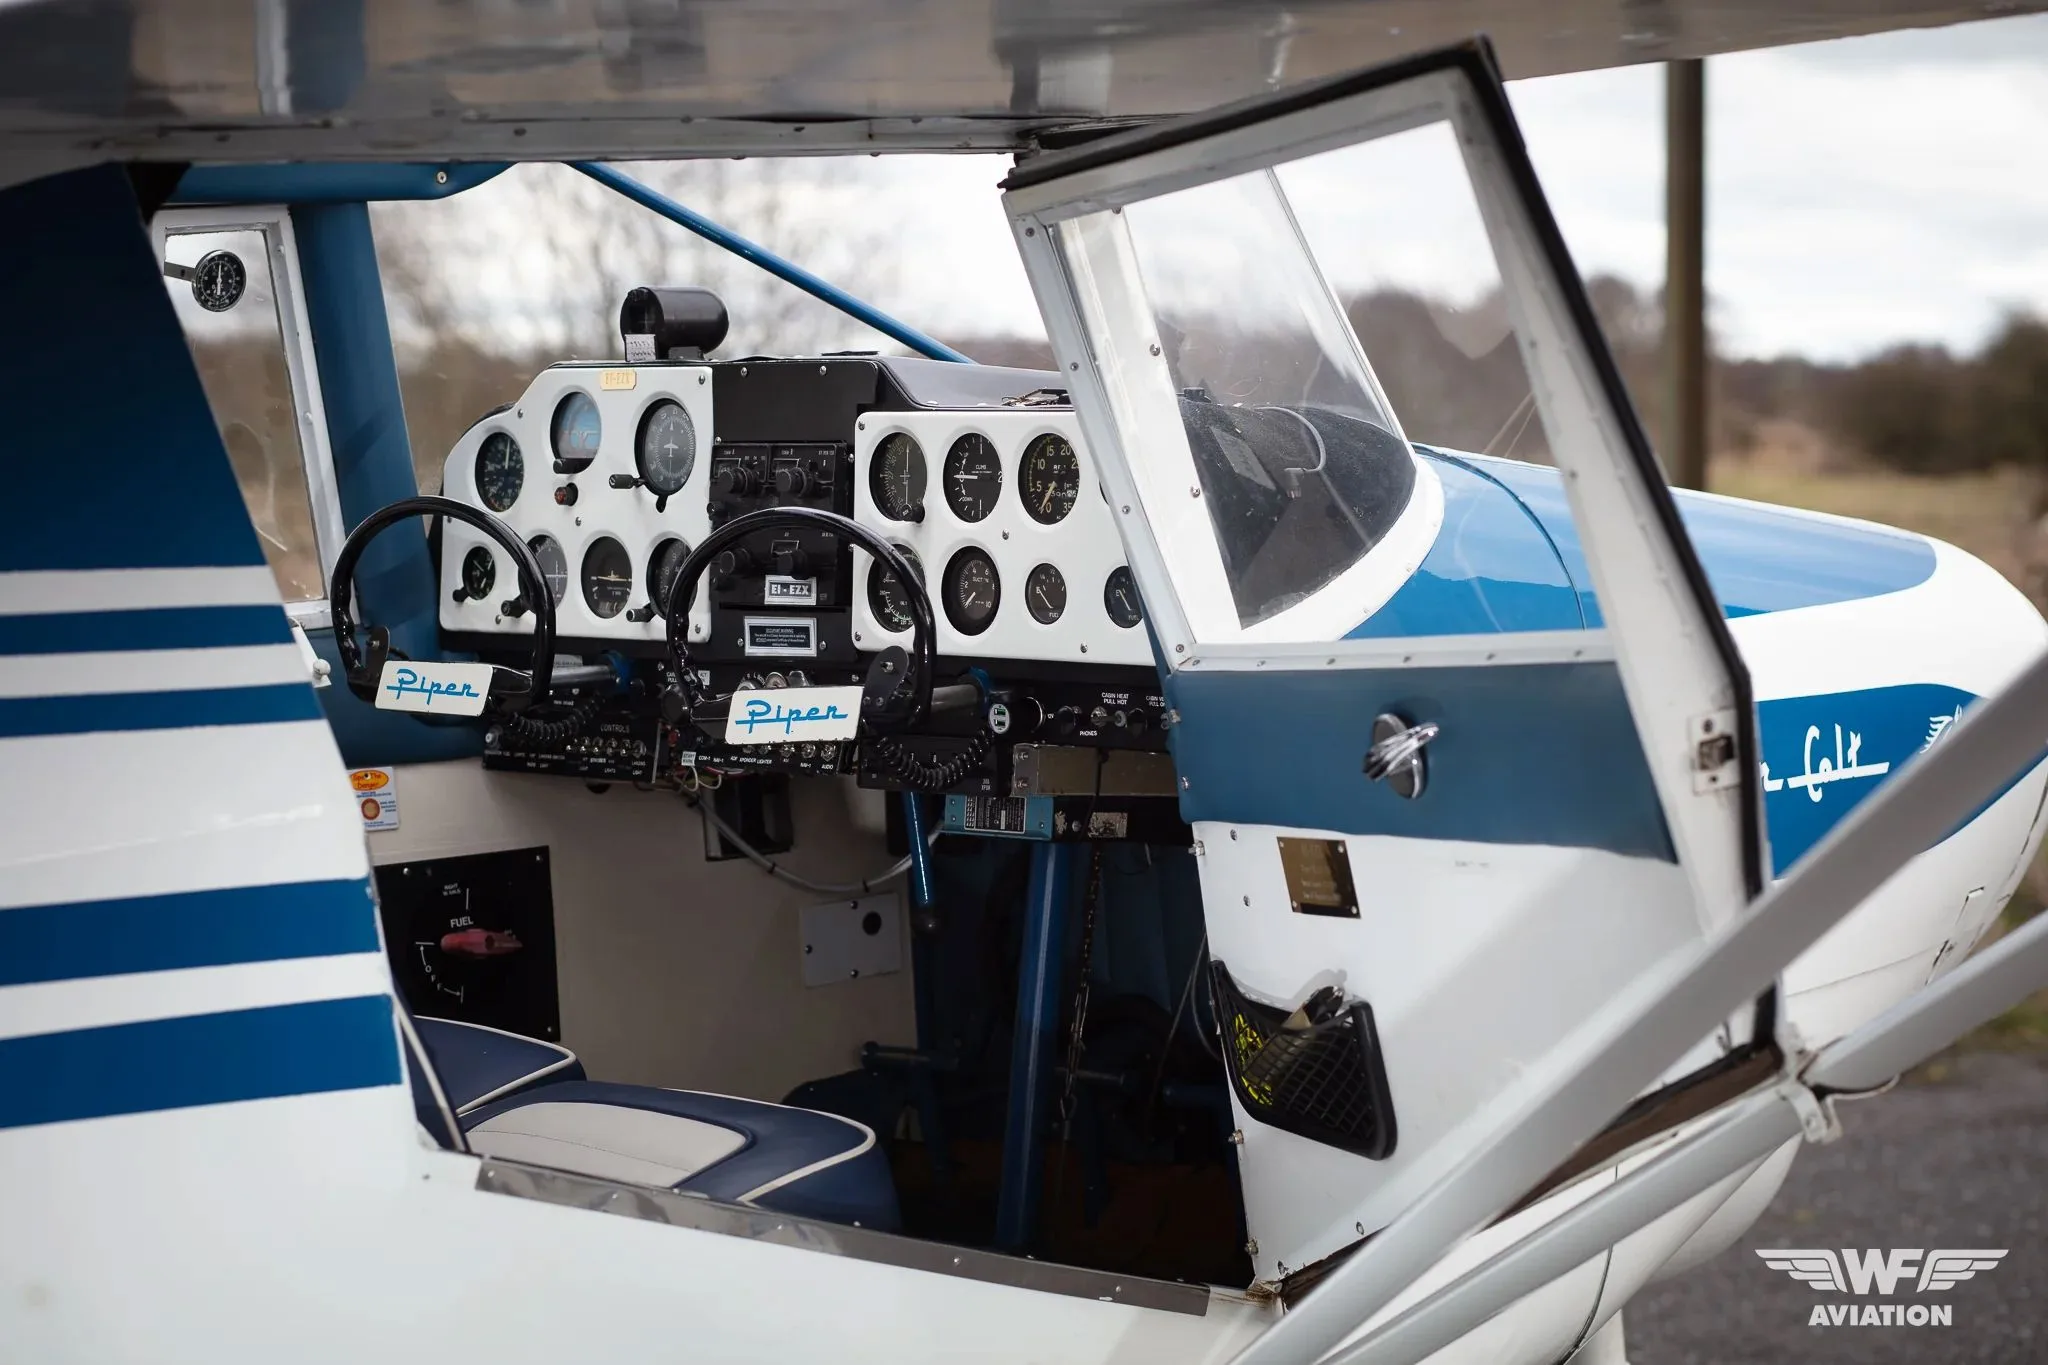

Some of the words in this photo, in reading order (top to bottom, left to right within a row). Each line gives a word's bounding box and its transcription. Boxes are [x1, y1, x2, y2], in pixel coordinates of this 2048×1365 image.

[1047, 445, 1054, 456] 15
[1061, 444, 1071, 456] 20
[1037, 458, 1046, 470] 10
[1036, 480, 1042, 492] 5
[386, 668, 480, 705] Piper
[735, 699, 848, 734] Piper
[1787, 724, 1890, 803] Colt
[450, 916, 474, 929] FUEL
